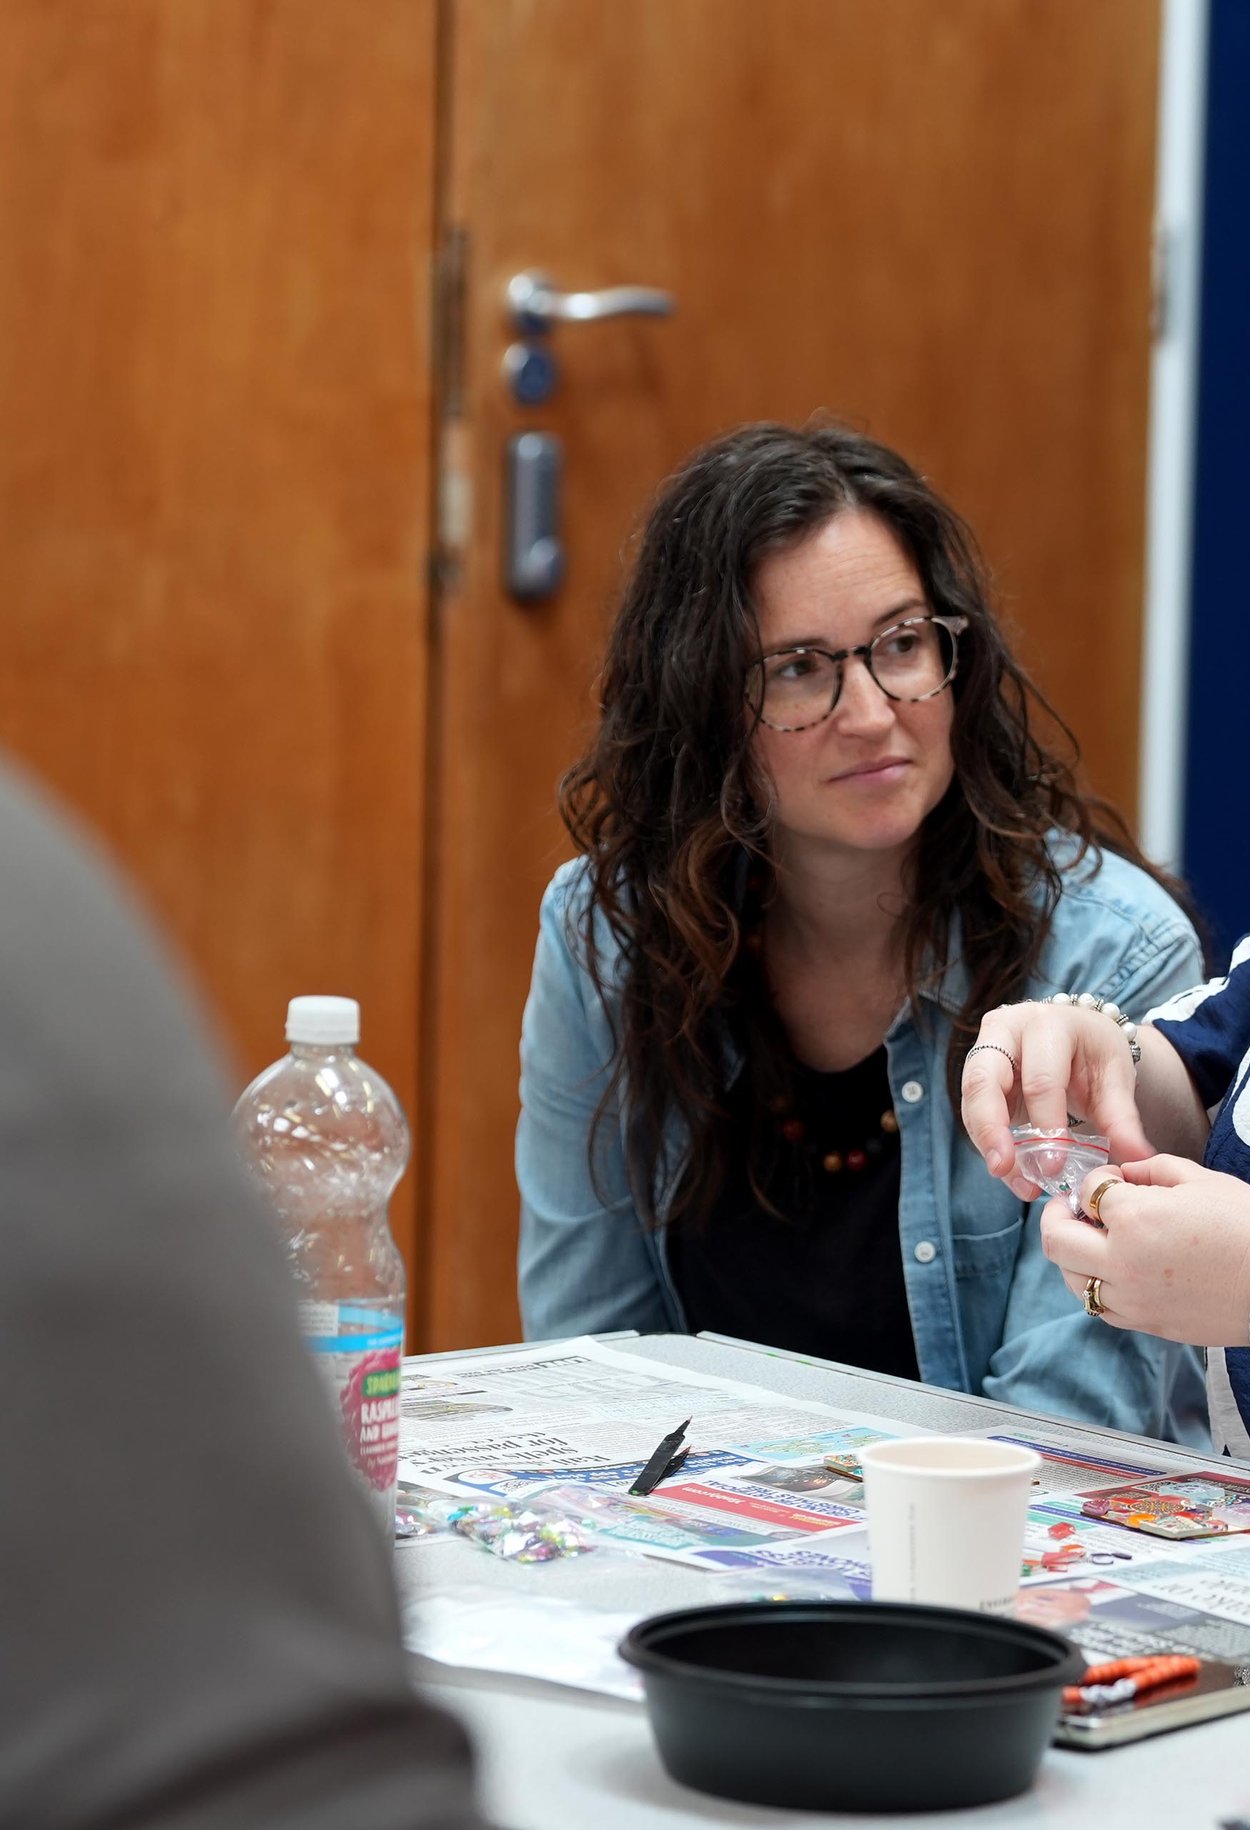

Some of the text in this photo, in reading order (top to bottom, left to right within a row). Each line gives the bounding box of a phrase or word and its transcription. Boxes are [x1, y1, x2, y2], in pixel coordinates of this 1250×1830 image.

[528, 1437, 569, 1447] for
[503, 1446, 579, 1461] spells
[552, 1455, 611, 1467] Rail
